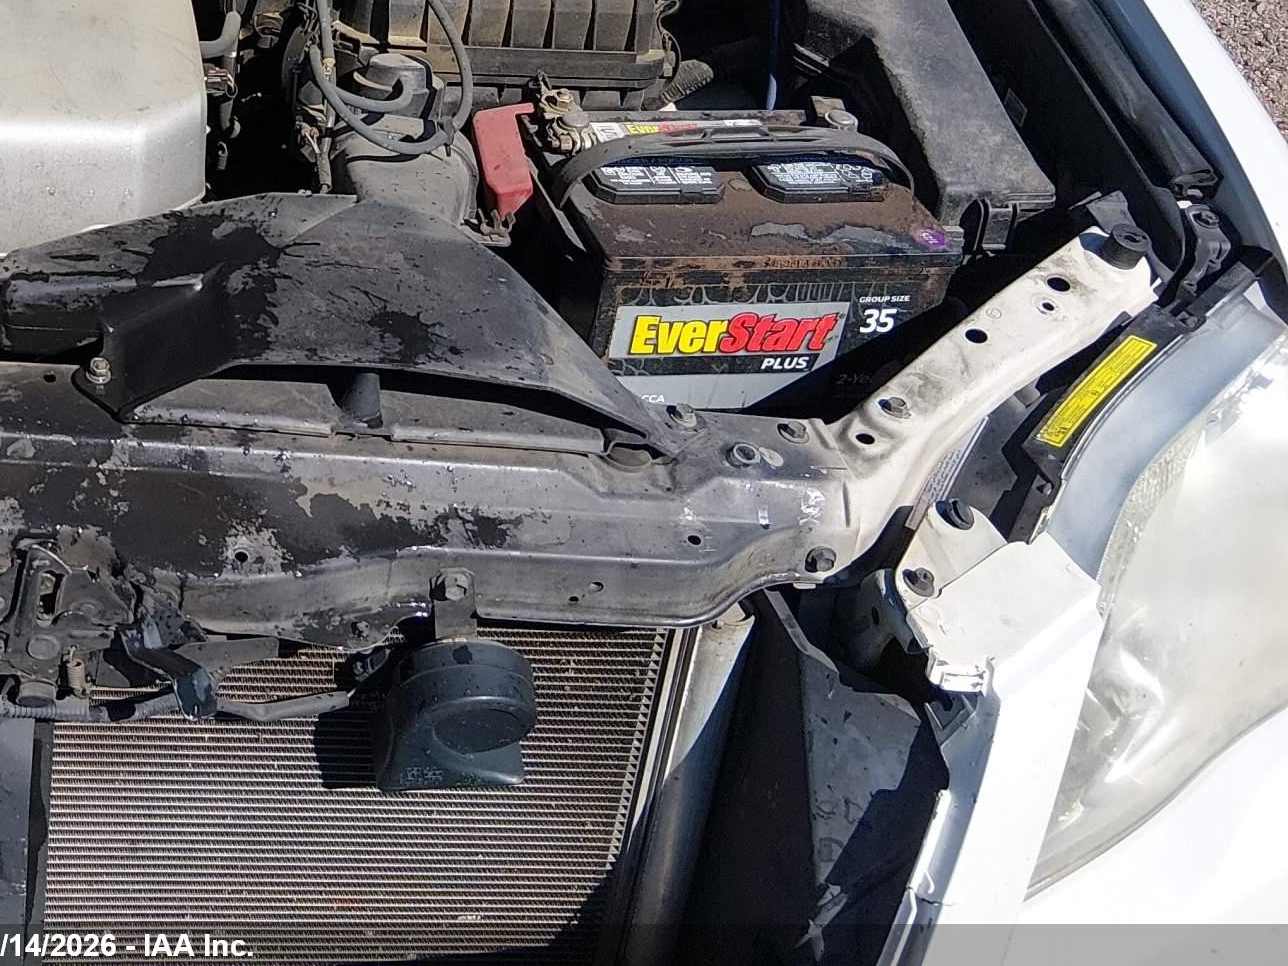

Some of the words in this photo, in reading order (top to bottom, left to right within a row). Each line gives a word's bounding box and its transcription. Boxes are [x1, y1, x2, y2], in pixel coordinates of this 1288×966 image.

[859, 295, 889, 303] GROUP
[890, 294, 910, 302] SIZE
[858, 308, 898, 333] 35
[628, 311, 840, 356] EverStart
[760, 356, 810, 370] PLUS
